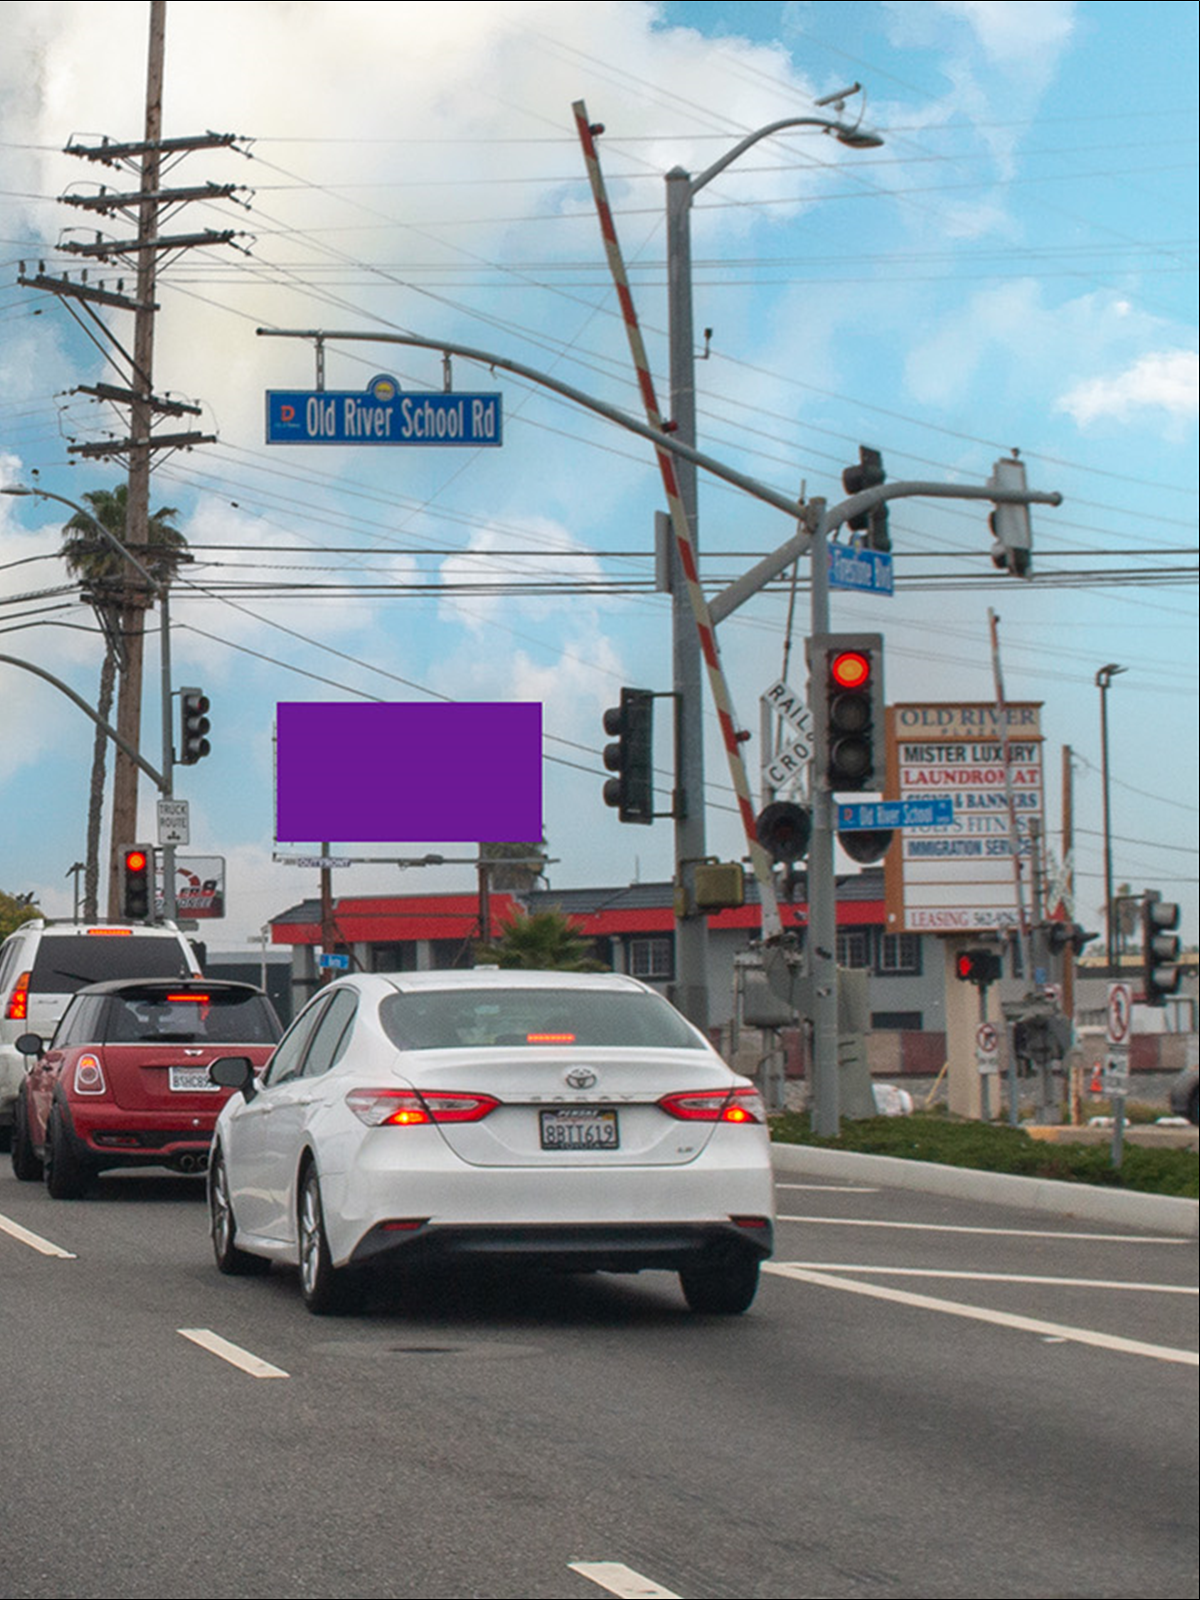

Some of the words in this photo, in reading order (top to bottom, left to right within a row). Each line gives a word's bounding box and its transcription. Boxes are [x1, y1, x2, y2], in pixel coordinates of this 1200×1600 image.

[306, 397, 336, 436] Old
[344, 399, 394, 436] River
[401, 398, 464, 437] School
[471, 399, 495, 437] Rd
[768, 685, 810, 732] RAIL
[901, 708, 954, 726] OLD
[960, 707, 1036, 725] RIVER
[904, 746, 966, 762] MISTER
[966, 793, 1037, 808] BANNRS
[160, 804, 187, 815] TRUCK
[859, 806, 874, 826] Old
[877, 805, 899, 824] River
[903, 803, 934, 823] School
[161, 818, 187, 828] ROUTE
[907, 841, 982, 856] IMMIGRATION
[911, 912, 968, 926] LEASING
